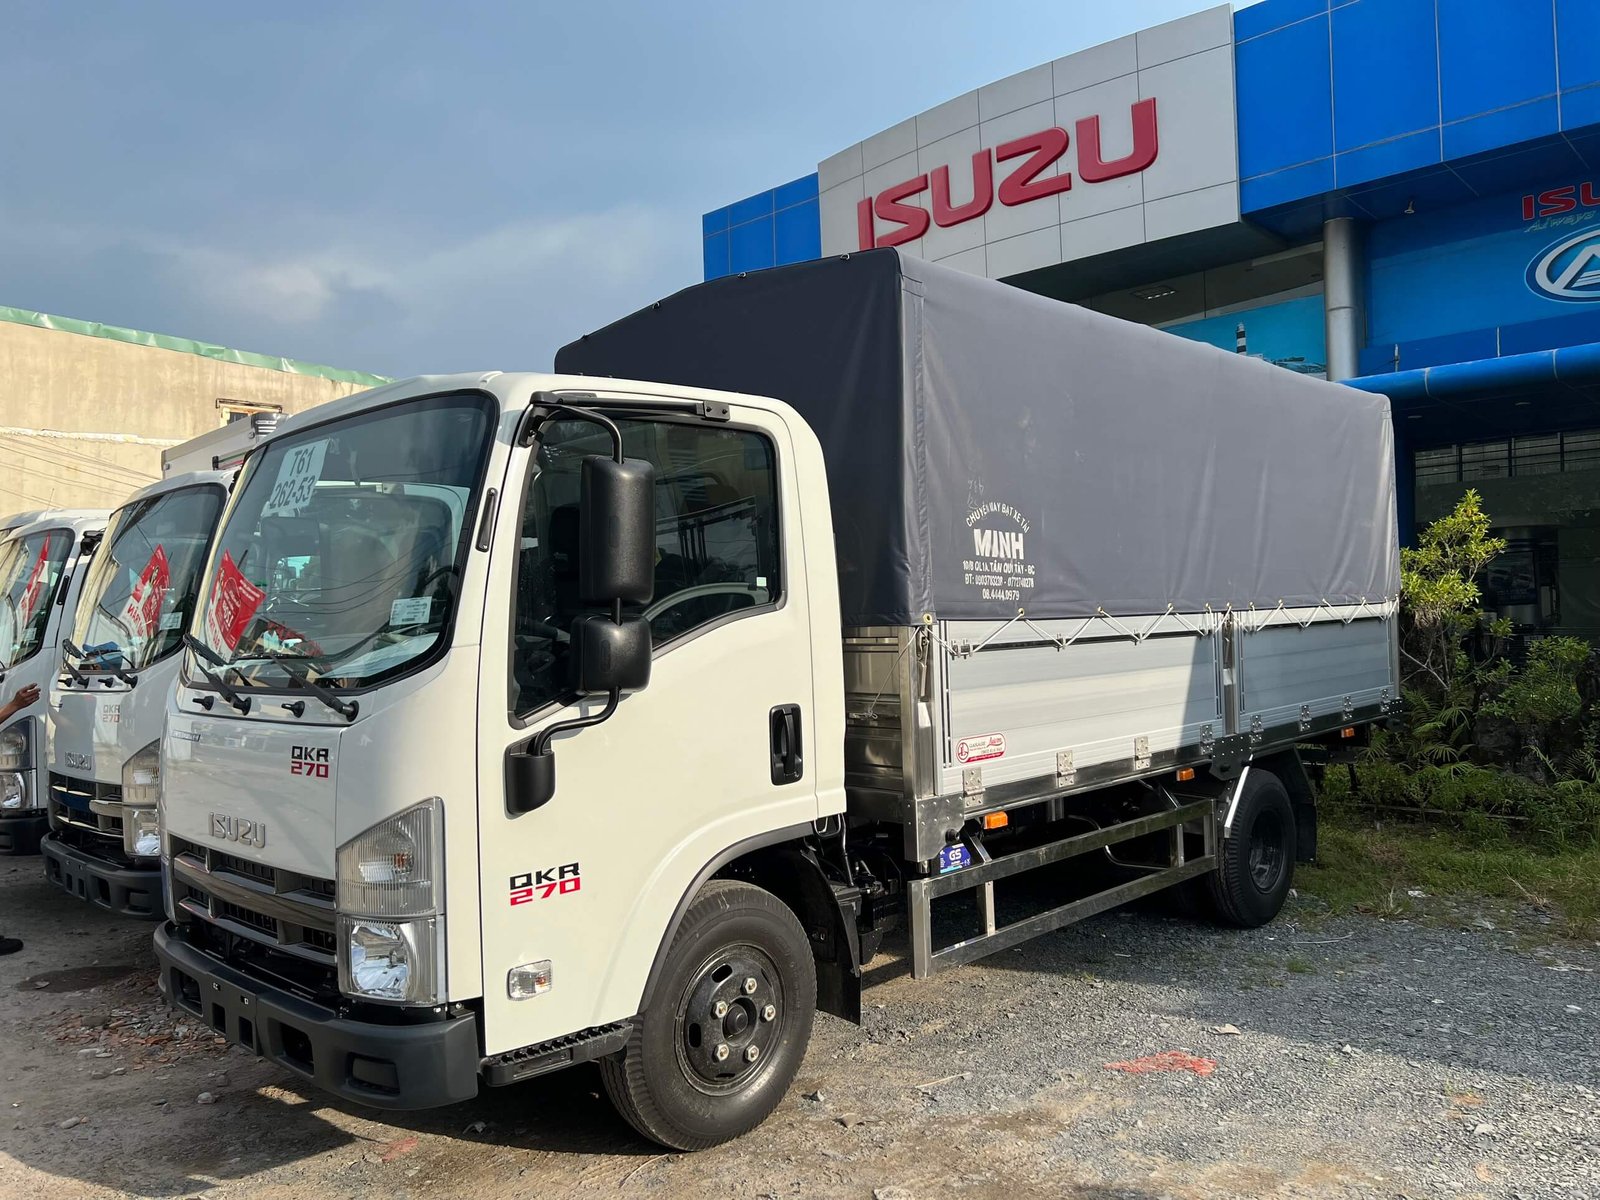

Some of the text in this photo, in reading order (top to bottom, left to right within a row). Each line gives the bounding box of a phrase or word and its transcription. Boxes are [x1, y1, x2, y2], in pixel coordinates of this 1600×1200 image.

[857, 97, 1158, 250] ISUZU
[290, 446, 317, 477] T61
[269, 475, 317, 511] 262-53
[973, 528, 1025, 560] MINH
[102, 714, 120, 723] 270
[103, 704, 121, 714] QKR
[291, 745, 329, 762] QKR
[291, 761, 329, 778] 270
[208, 811, 266, 848] ISUZU
[949, 848, 962, 861] GS
[509, 861, 581, 890] QKR
[509, 877, 581, 906] 270
